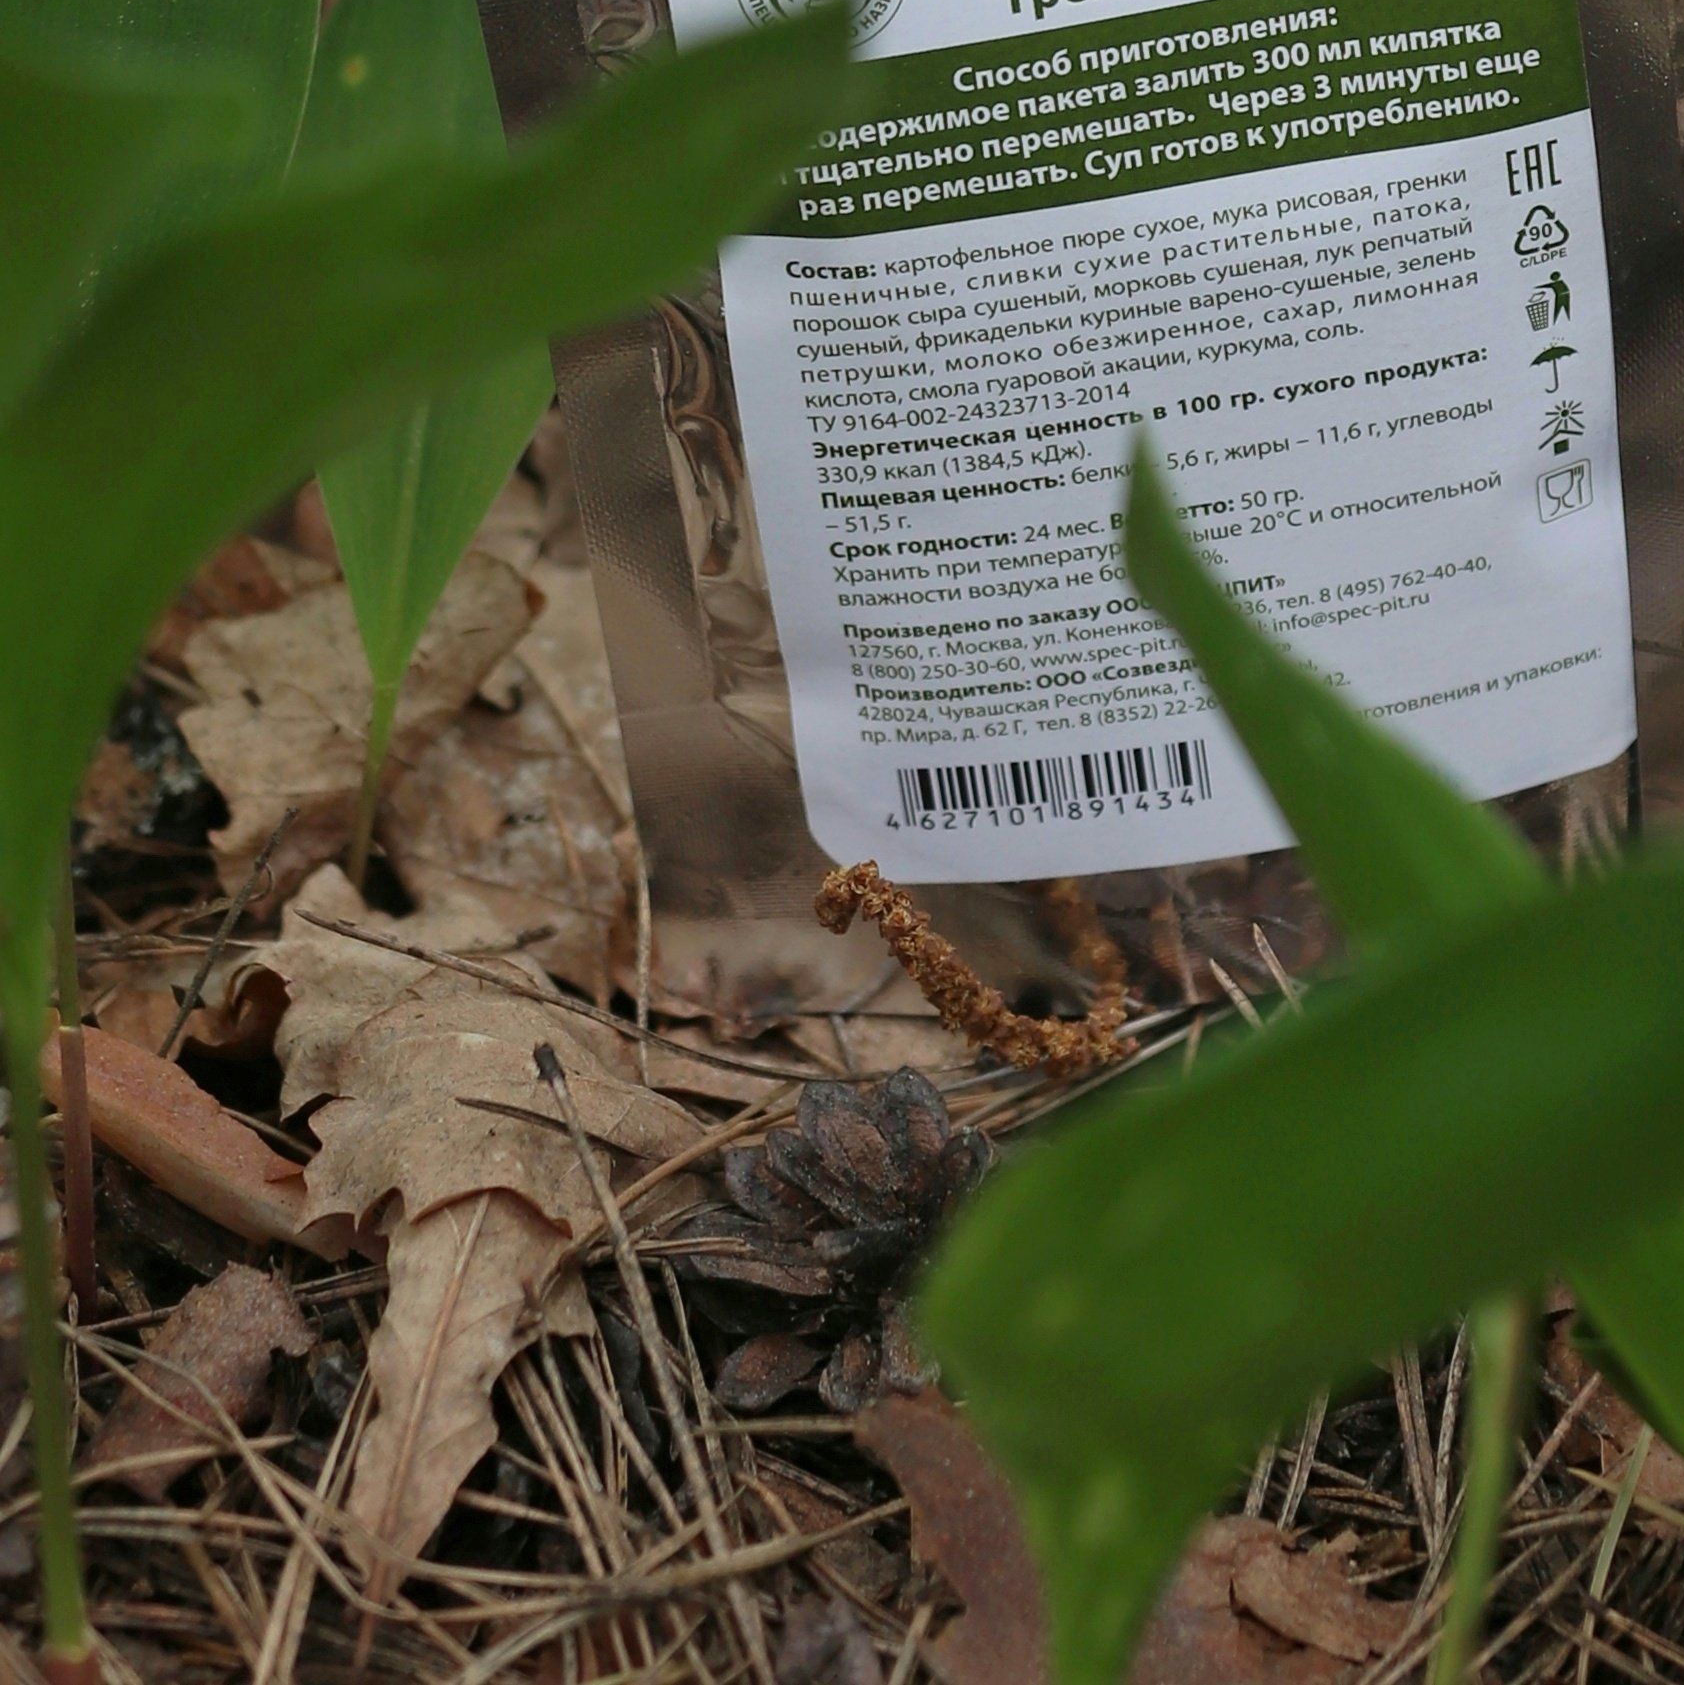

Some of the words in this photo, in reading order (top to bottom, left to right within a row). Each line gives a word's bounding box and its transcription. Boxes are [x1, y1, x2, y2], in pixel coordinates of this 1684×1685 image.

[808, 102, 1010, 151] одержимое
[1018, 81, 1128, 117] пакета
[1136, 62, 1245, 97] залить
[1253, 44, 1310, 74] 300
[1317, 42, 1361, 64] мл
[1370, 21, 1502, 56] кипятка
[953, 49, 1071, 93] Способ
[1081, 7, 1338, 74] приготовления:
[795, 141, 974, 187] тщательно
[982, 106, 1194, 156] перемешать.
[1209, 84, 1306, 117] Через
[1313, 74, 1332, 100] 3
[1340, 61, 1466, 98] минуты
[1476, 50, 1540, 79] еще
[799, 194, 854, 220] раз
[863, 163, 1077, 213] перемешать.
[1085, 148, 1142, 180] Суп
[1151, 130, 1238, 163] готов
[1246, 125, 1266, 146] к
[1271, 89, 1520, 149] употреблению.
[786, 260, 876, 279] Состав:
[886, 237, 1053, 276] картофельное
[1063, 227, 1125, 250] пюре
[1134, 216, 1204, 242] сухое,
[1213, 203, 1267, 229] мука
[1278, 186, 1378, 220] рисовая,
[1387, 169, 1466, 199] гренки
[790, 281, 955, 305] пшеничные,
[967, 263, 1062, 290] сливки
[1075, 249, 1150, 277] сухие
[1163, 218, 1362, 265] растительные,
[1374, 198, 1471, 226] патока,
[1519, 247, 1568, 268] C/LDPE
[1529, 223, 1553, 242] 90
[793, 311, 900, 337] порошок
[907, 303, 965, 326] сыра
[975, 284, 1086, 319] сушеный,
[1095, 269, 1195, 299] морковь
[1204, 252, 1308, 284] сушеная,
[1315, 242, 1354, 265] лук
[1362, 215, 1473, 259] репчатый
[797, 332, 908, 362] сушеный,
[916, 315, 1072, 354] фрикадельки
[1080, 301, 1181, 331] куриные
[1189, 264, 1390, 313] варено-сушеные,
[1398, 246, 1476, 272] зелень
[801, 361, 934, 386] петрушки,
[946, 347, 1042, 371] молоко
[1054, 317, 1253, 358] обезжиренное,
[1263, 300, 1342, 325] сахар,
[1353, 272, 1479, 307] лимонная
[805, 390, 902, 409] кислота,
[909, 381, 978, 402] смола
[987, 358, 1095, 396] гуаровой
[1103, 351, 1191, 375] акации,
[1198, 333, 1299, 365] куркума,
[1306, 322, 1364, 343] соль.
[807, 414, 836, 434] ТУ
[843, 380, 1130, 432] 9164-002-24323713-2014
[813, 427, 1016, 460] Энергетическая
[1026, 408, 1144, 442] ценность
[1153, 405, 1167, 420] в
[1177, 392, 1221, 416] 100
[1231, 390, 1264, 411] гр.
[1274, 374, 1354, 404] сухого
[1365, 347, 1488, 387] продукта:
[818, 463, 876, 486] 330,9
[884, 462, 935, 480] ккал
[943, 448, 1024, 481] (1384,5
[1031, 439, 1091, 467] кДж).
[822, 488, 935, 510] Пищевая
[943, 474, 1065, 504] ценность:
[1167, 448, 1199, 473] 5,6
[1225, 438, 1290, 461] жиры
[1317, 419, 1361, 445] 11,6
[1368, 420, 1381, 438] г,
[1387, 398, 1493, 437] углеводы
[829, 540, 890, 564] Срок
[898, 530, 1017, 556] годности:
[1024, 522, 1050, 543] 24
[1057, 520, 1105, 539] мес.
[1177, 498, 1235, 520] етто:
[1241, 490, 1266, 511] 50
[1274, 489, 1304, 510] гр.
[834, 564, 929, 588] Хранить
[938, 560, 980, 582] при
[988, 542, 1124, 572] температур
[1309, 509, 1323, 524] и
[1330, 468, 1501, 520] относительной
[845, 512, 890, 536] 51,5
[839, 585, 961, 607] влажности
[969, 575, 1059, 599] воздуха
[1067, 570, 1093, 587] не
[844, 616, 988, 642] Произведено
[997, 613, 1022, 629] по
[1029, 602, 1100, 625] заказу
[849, 640, 924, 664] 127560,
[947, 636, 1028, 656] Москва,
[1034, 631, 1061, 652] ул.
[1067, 614, 1175, 641] Коненков
[1277, 592, 1313, 609] тел.
[1320, 583, 1330, 601] 8
[1337, 573, 1384, 605] (495)
[1391, 554, 1491, 589] 762-40-40,
[852, 659, 863, 677] 8
[868, 657, 915, 683] (800)
[922, 653, 1026, 676] 250-30-60,
[1273, 590, 1430, 631] info@spec-pit.ru
[855, 676, 1031, 703] Производитель:
[1036, 666, 1086, 689] ООО
[859, 701, 934, 726] 428024,
[938, 697, 1049, 723] Чувашская
[1055, 682, 1178, 709] Республика,
[862, 728, 891, 748] пр.
[897, 724, 958, 747] Мира,
[985, 717, 1008, 736] 62
[1037, 715, 1074, 731] тел.
[1081, 708, 1092, 726] 8
[1098, 698, 1157, 730] (8352)
[1361, 681, 1480, 720] готовления
[1487, 677, 1499, 691] и
[1503, 646, 1602, 693] упаковки:
